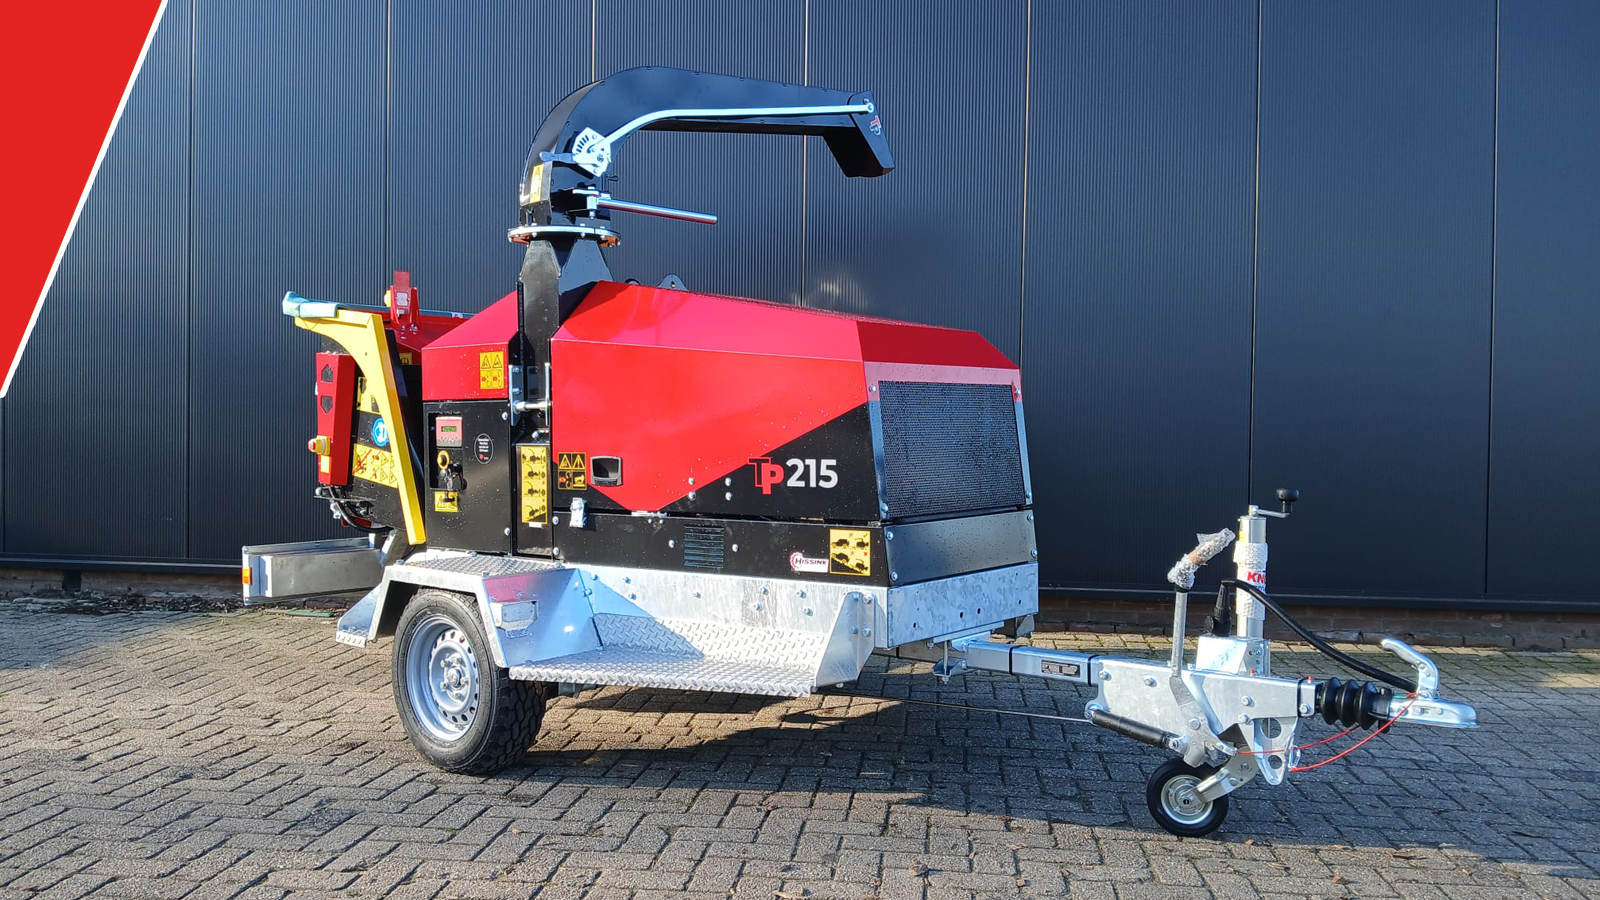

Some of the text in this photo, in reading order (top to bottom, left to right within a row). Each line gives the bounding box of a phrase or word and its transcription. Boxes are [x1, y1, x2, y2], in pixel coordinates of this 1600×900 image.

[747, 456, 838, 495] TP 215
[1247, 571, 1267, 584] KN
